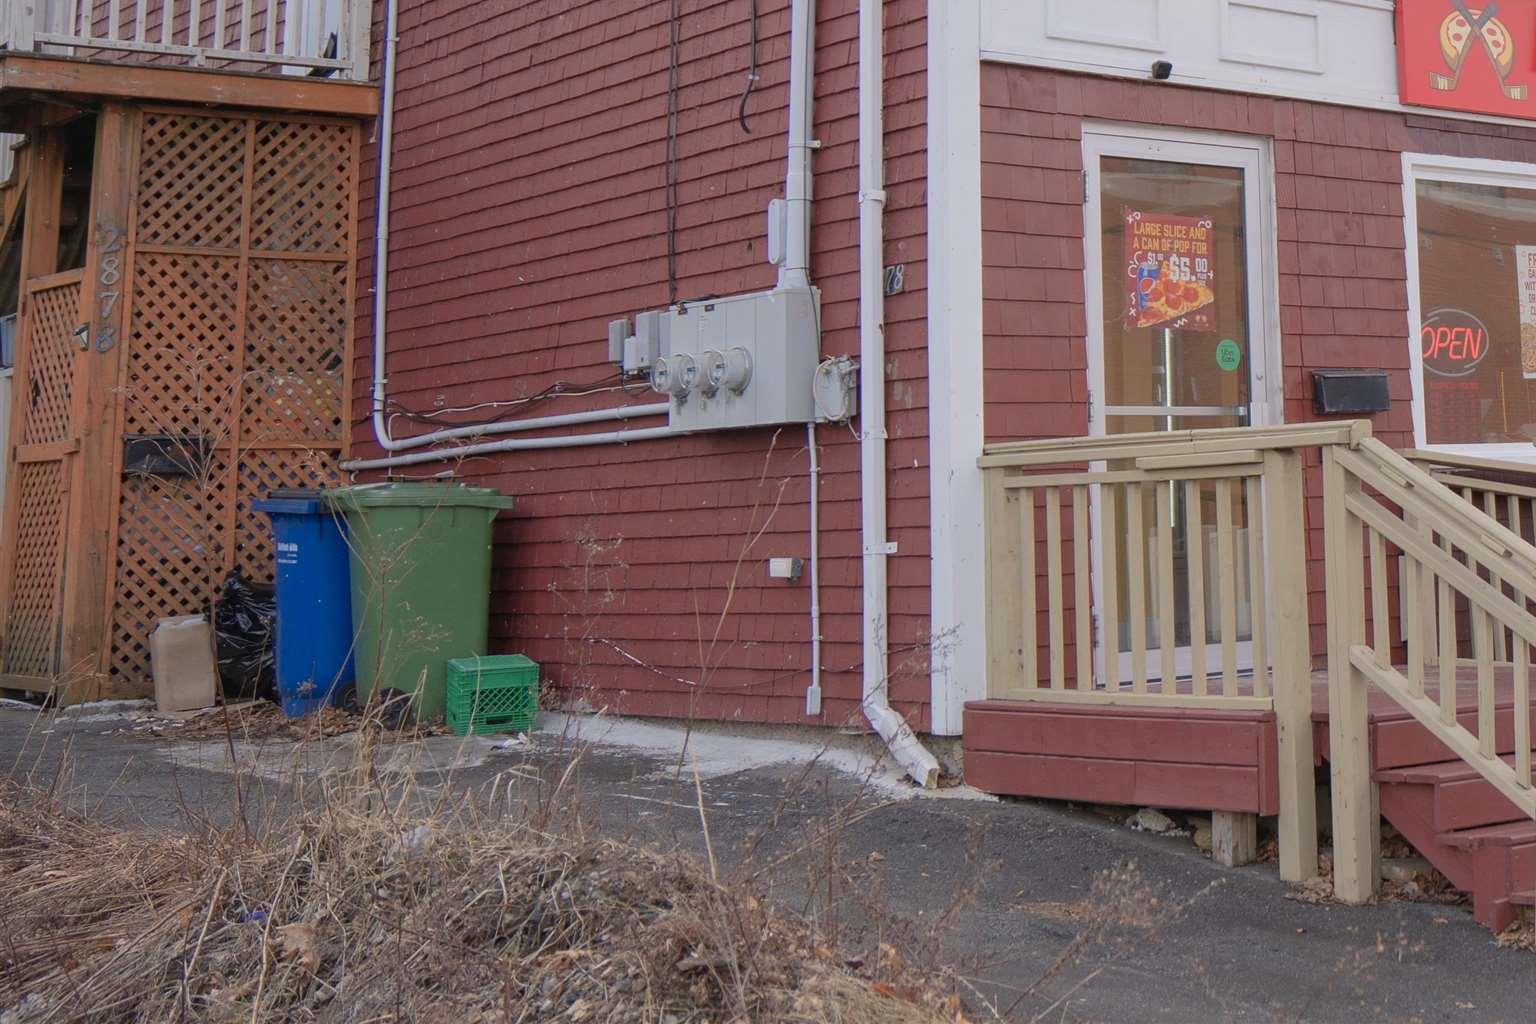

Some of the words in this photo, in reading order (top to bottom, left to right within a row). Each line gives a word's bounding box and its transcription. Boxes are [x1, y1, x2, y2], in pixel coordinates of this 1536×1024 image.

[1134, 222, 1162, 236] LARGE
[1163, 224, 1187, 238] SLICE
[1189, 227, 1206, 240] AND
[1132, 236, 1140, 249] A
[1141, 237, 1160, 250] CAN
[1161, 238, 1171, 251] OF
[1174, 239, 1190, 252] POP
[1191, 241, 1208, 254] FOR
[1421, 326, 1482, 359] OPEN
